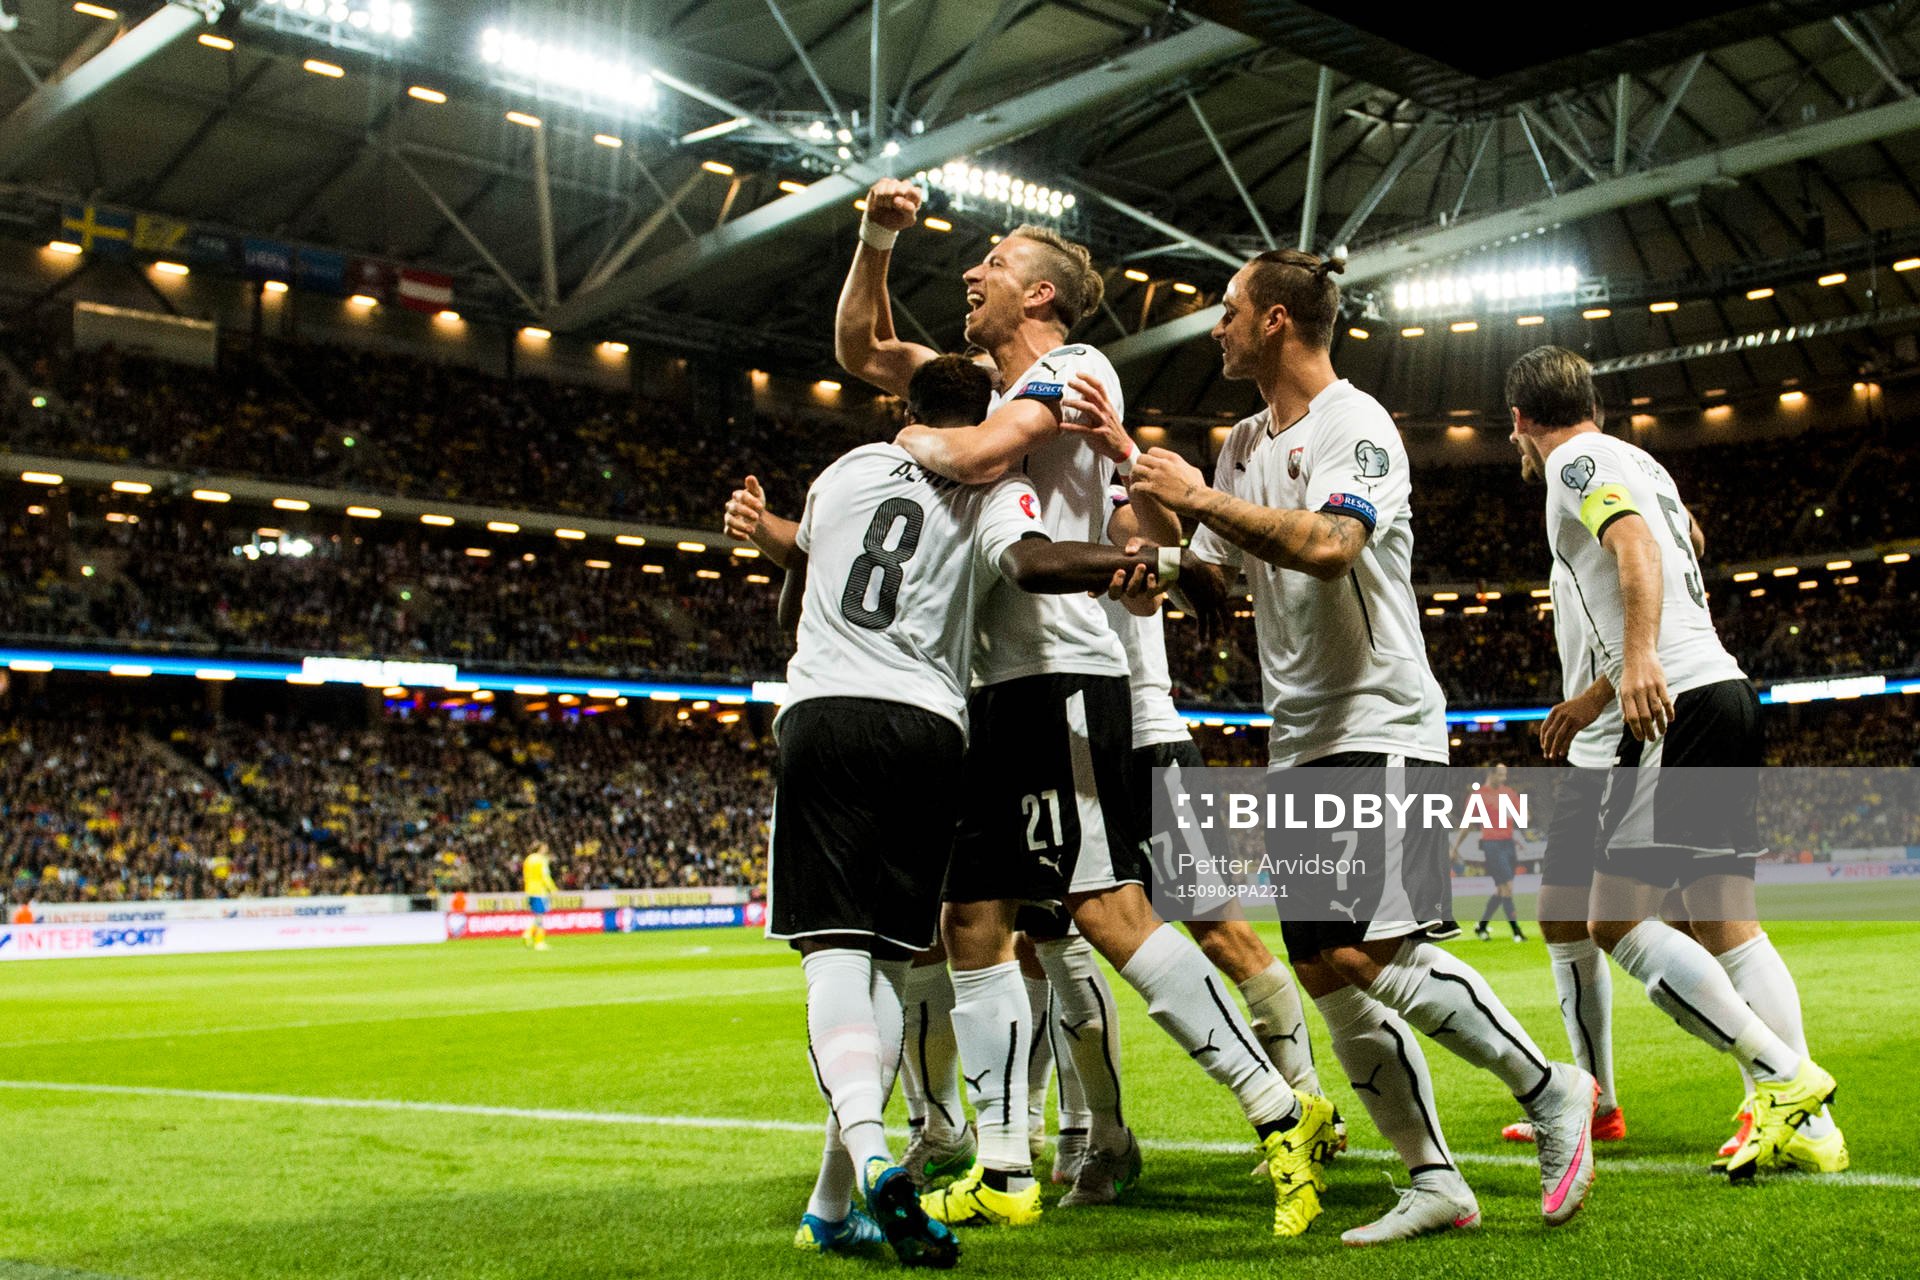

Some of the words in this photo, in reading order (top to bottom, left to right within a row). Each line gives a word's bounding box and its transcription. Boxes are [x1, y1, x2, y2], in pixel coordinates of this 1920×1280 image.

[1026, 384, 1061, 394] RESPECT
[841, 497, 924, 629] 8
[1656, 492, 1704, 609] 5
[1022, 789, 1063, 850] 21
[1331, 831, 1358, 890] 7
[18, 927, 166, 949] INTERSPORT
